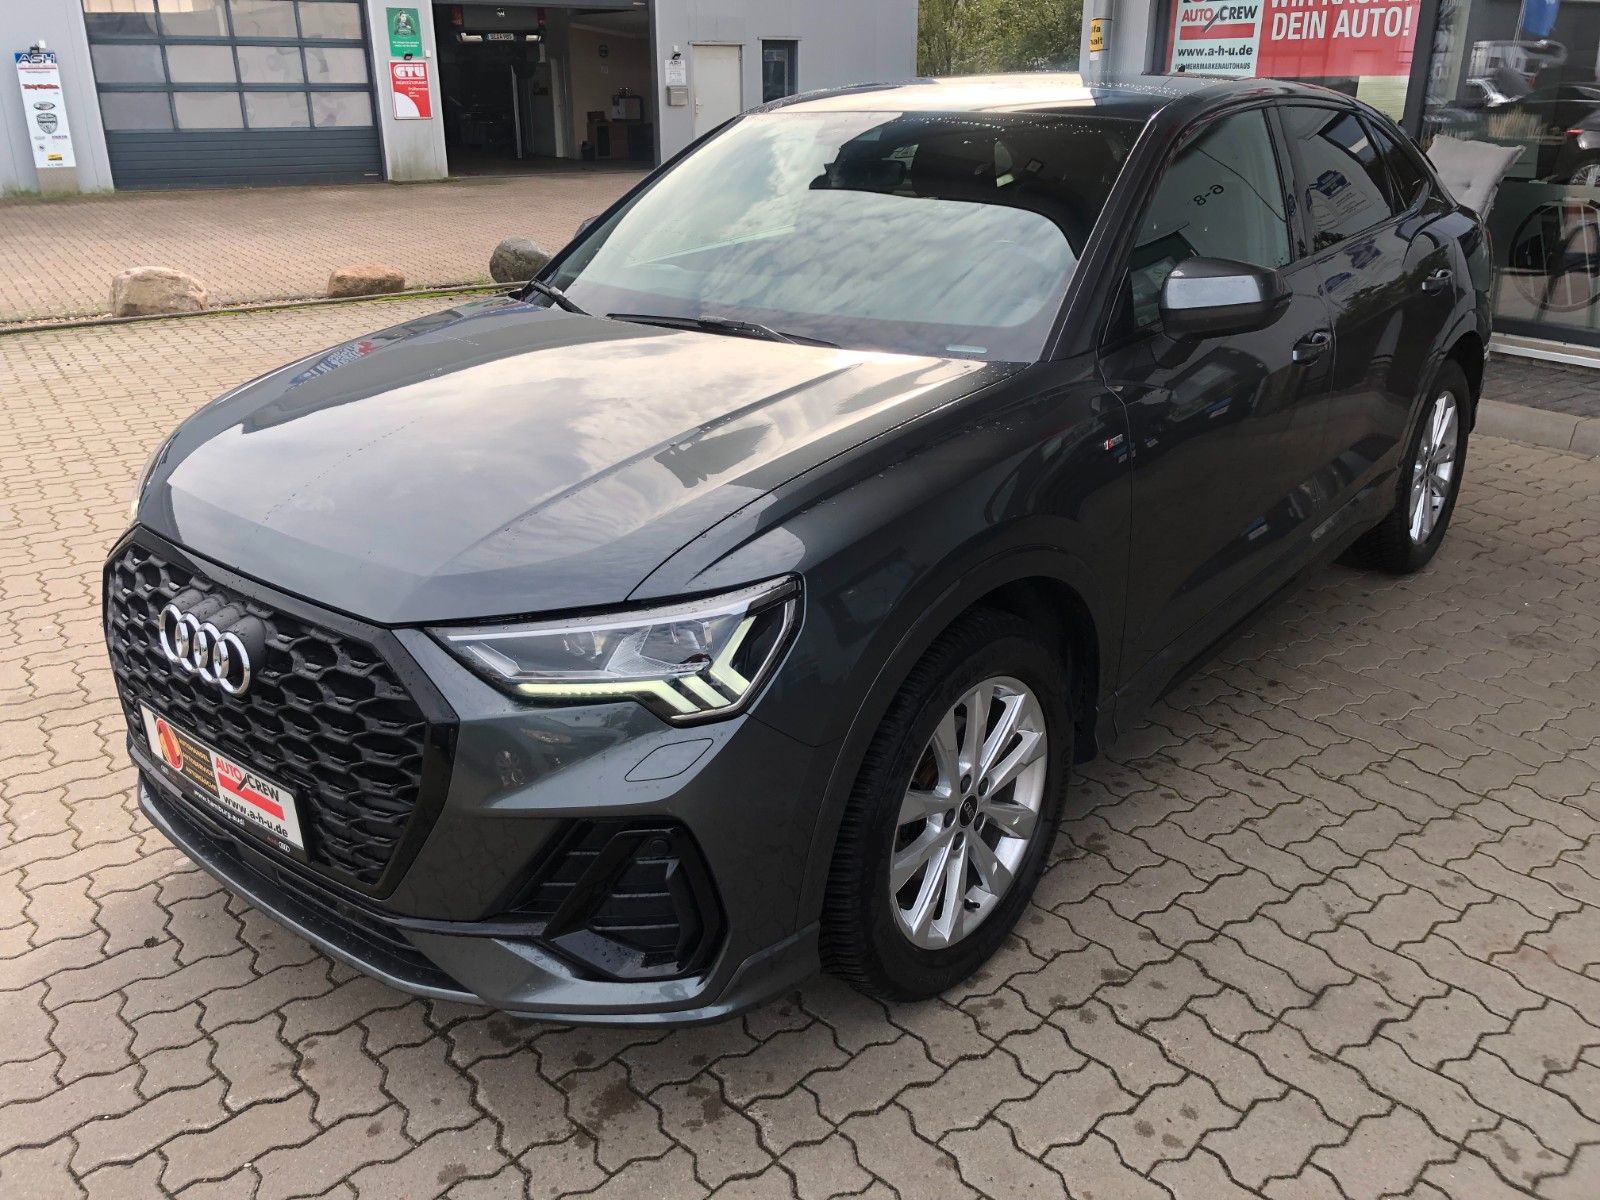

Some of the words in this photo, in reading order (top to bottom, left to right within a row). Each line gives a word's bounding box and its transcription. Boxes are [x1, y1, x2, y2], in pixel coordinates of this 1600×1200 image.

[1182, 8, 1214, 22] AUTO
[1219, 5, 1258, 21] CREW
[1271, 11, 1328, 40] DEIN
[1332, 6, 1412, 38] AUTO!
[18, 53, 56, 64] ASH
[1178, 45, 1253, 57] www.a-h-u.de
[216, 757, 243, 781] AUTO
[246, 773, 280, 803] CREW
[223, 795, 288, 838] www.a-h-u.de
